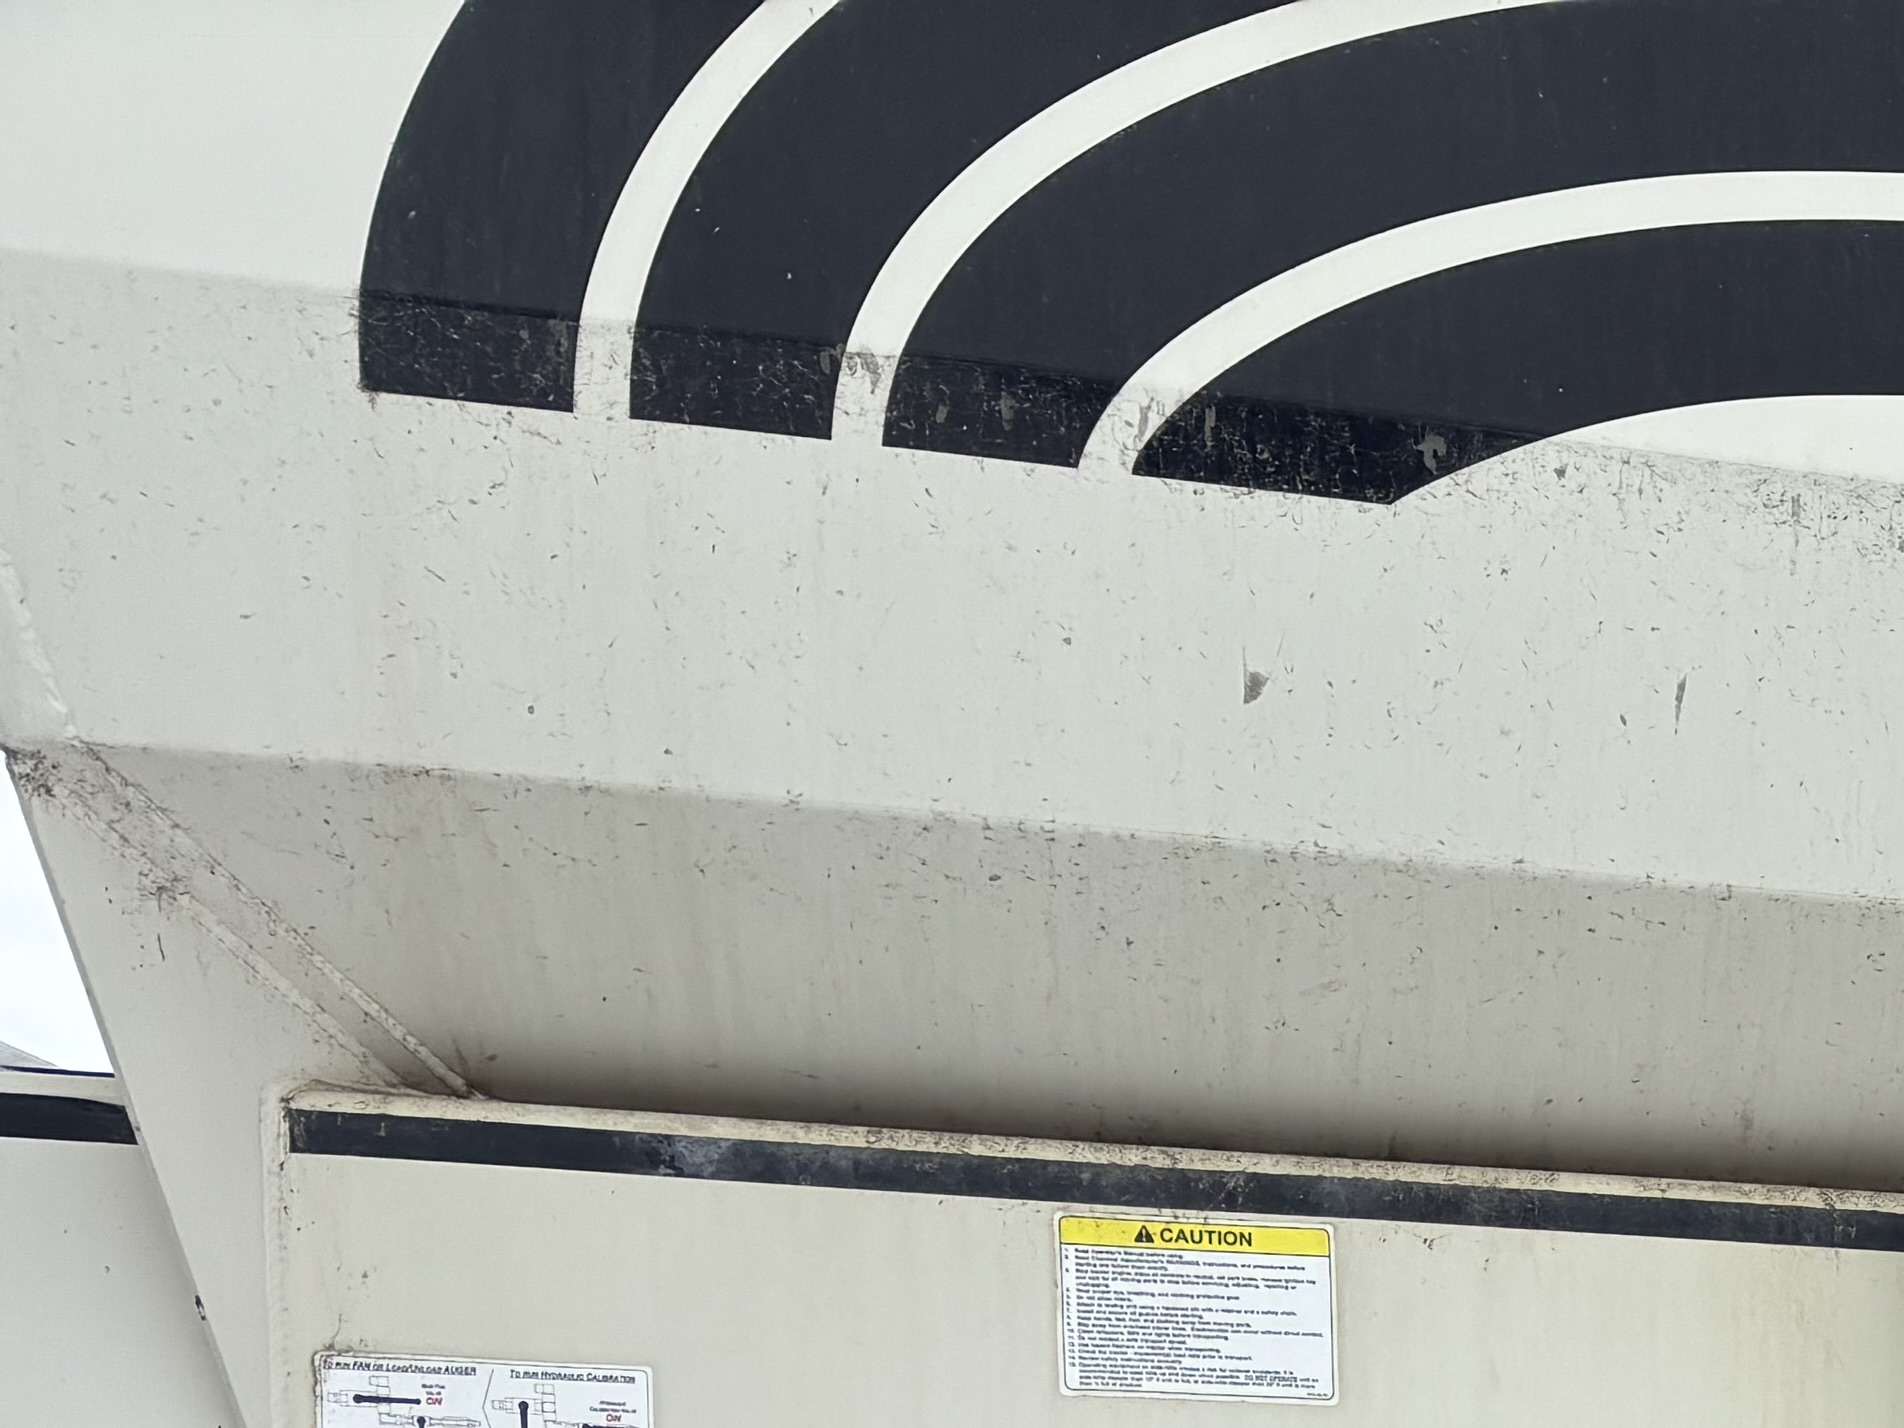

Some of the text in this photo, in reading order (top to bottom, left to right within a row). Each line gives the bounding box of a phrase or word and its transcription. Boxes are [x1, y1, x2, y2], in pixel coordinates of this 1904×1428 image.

[1159, 1227, 1252, 1247] CAUTION
[426, 1397, 443, 1406] ON
[606, 1414, 622, 1423] ON
